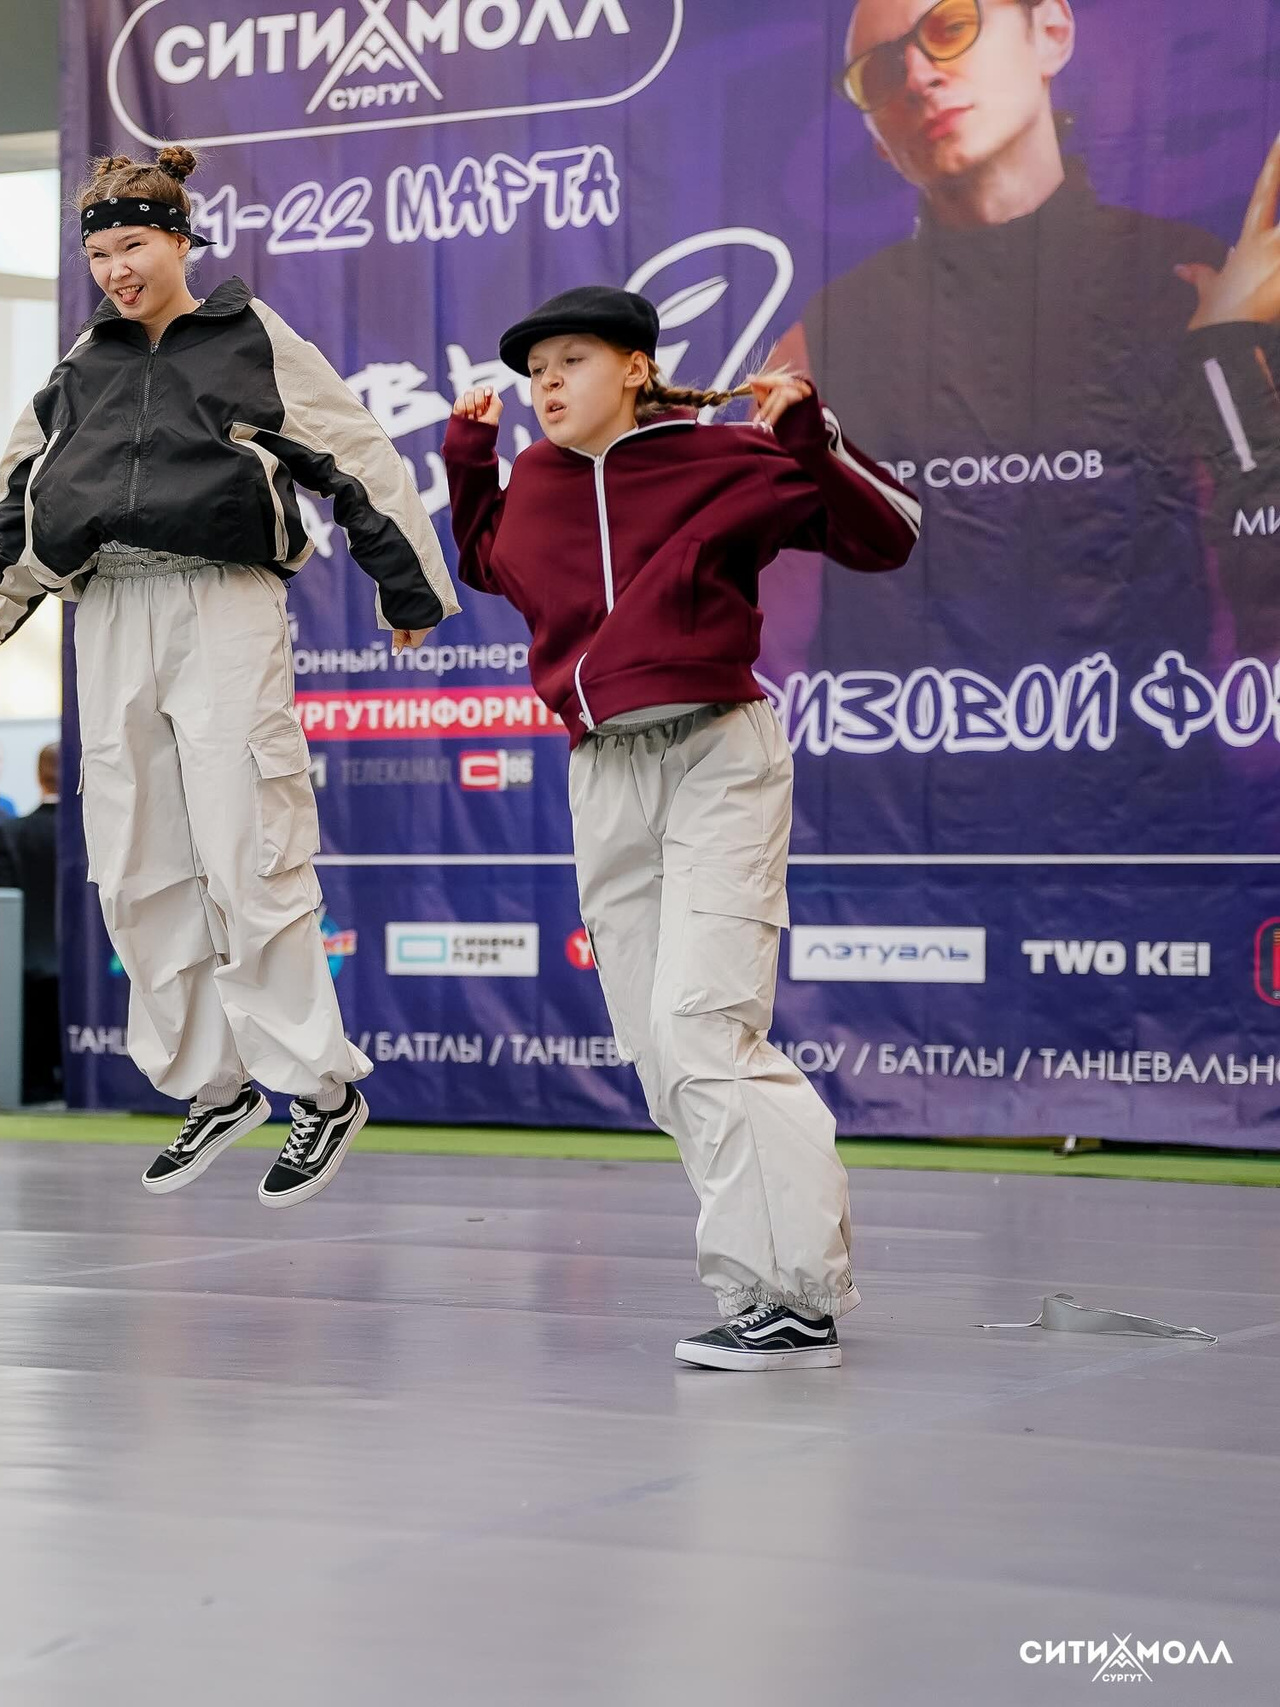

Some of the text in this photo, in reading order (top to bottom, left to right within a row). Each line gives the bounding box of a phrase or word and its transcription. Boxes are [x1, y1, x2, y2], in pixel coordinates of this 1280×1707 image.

[154, 0, 631, 84] СИТИ МОЛЛ
[327, 80, 421, 111] СУРГУТ
[385, 144, 622, 245] МАРТА
[923, 449, 1105, 488] СОКОЛОВ
[393, 642, 529, 677] партнер
[293, 696, 565, 730] РГУТИНФОРМТ
[1130, 649, 1280, 749] ФО
[452, 951, 500, 969] парк
[1021, 940, 1212, 977] TWO KEI
[375, 1031, 484, 1063] БАТТЛЫ
[508, 1033, 637, 1069] ТАНЦЕВ
[877, 1043, 1005, 1078] БАТТЛЫ
[1038, 1047, 1280, 1086] ТАНЦЕВАЛЬН
